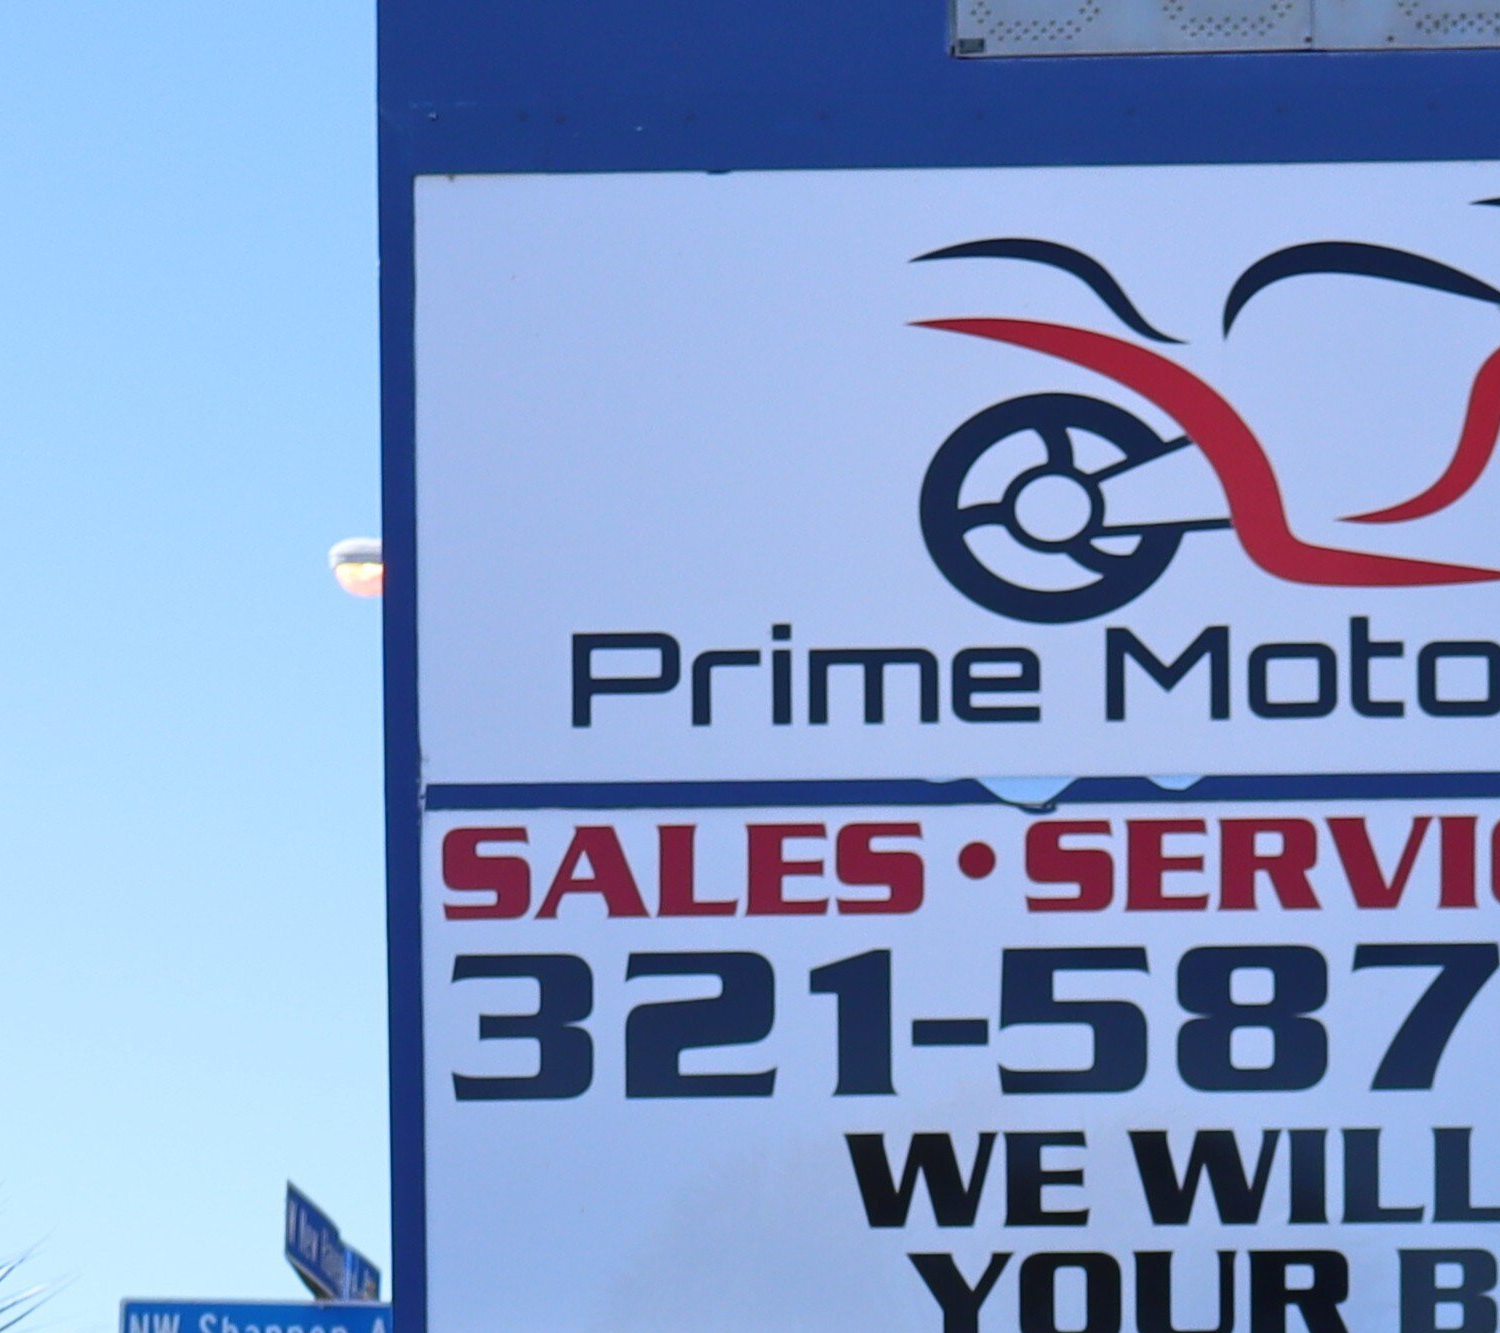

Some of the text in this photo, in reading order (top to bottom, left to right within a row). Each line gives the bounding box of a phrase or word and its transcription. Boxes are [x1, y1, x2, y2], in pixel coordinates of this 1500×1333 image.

[571, 623, 1042, 728] Prime
[441, 823, 925, 921] SALES
[845, 1131, 1090, 1229] WE
